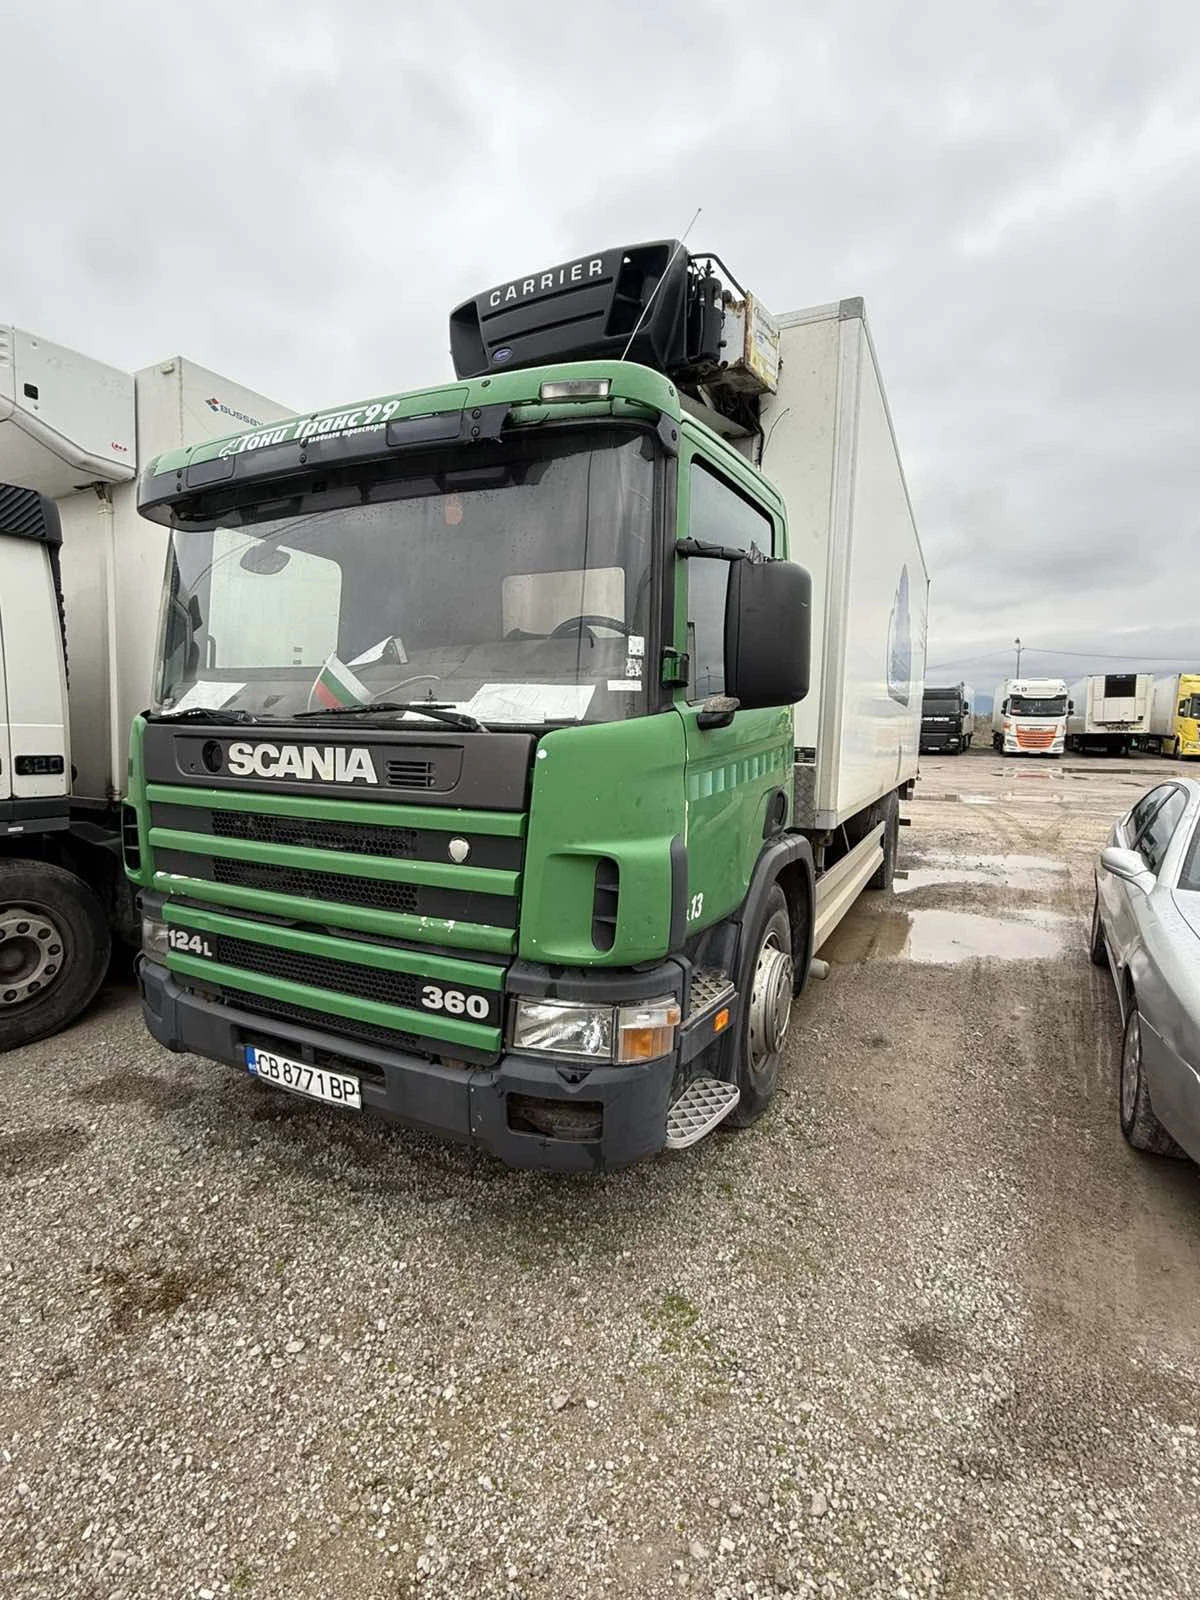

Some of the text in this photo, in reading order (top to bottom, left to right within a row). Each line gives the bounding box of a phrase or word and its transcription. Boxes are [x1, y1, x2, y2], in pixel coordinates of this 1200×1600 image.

[490, 259, 603, 306] CARRIER
[236, 423, 293, 453] Тони
[228, 742, 379, 784] SCANIA
[169, 929, 213, 957] 124L
[421, 985, 490, 1019] 360
[258, 1053, 356, 1102] CB 8771 BP
